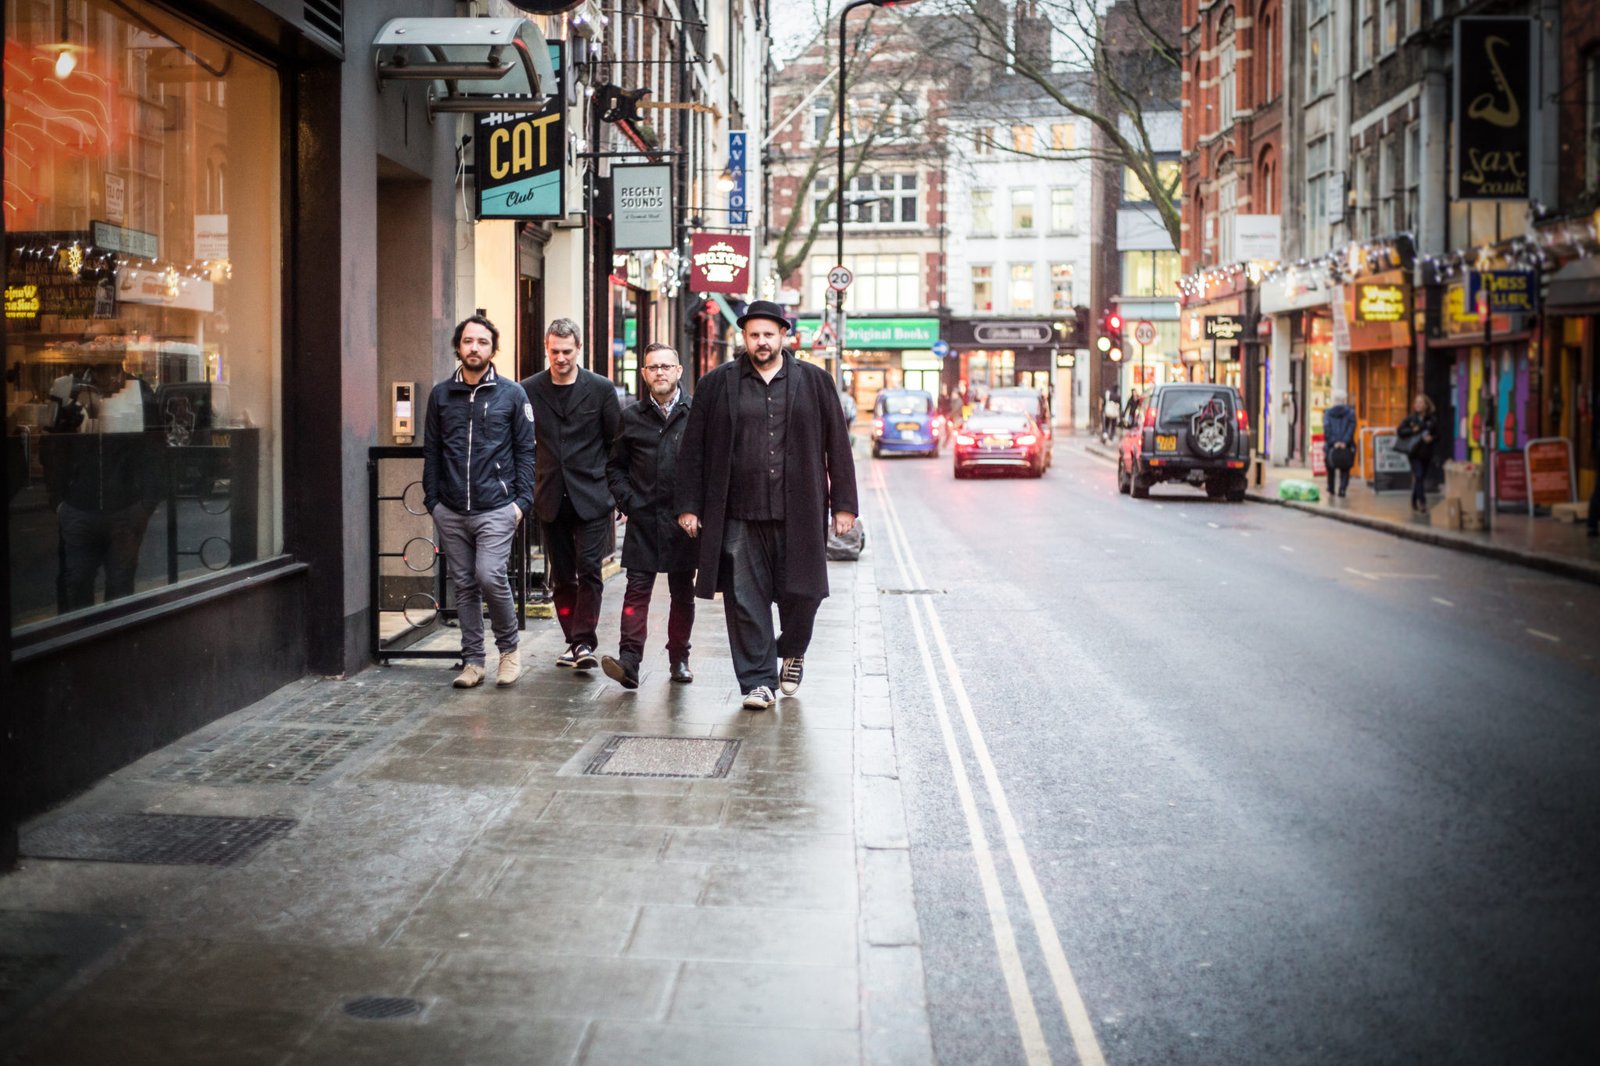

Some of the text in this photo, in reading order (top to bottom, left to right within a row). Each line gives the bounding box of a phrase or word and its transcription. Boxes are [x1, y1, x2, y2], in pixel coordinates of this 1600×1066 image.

[489, 112, 560, 180] CAT
[729, 134, 744, 223] AVALON
[505, 187, 535, 208] Club
[621, 186, 663, 198] REGENT
[621, 197, 664, 209] SOUNDS
[831, 273, 849, 284] 20
[1138, 328, 1153, 338] 30
